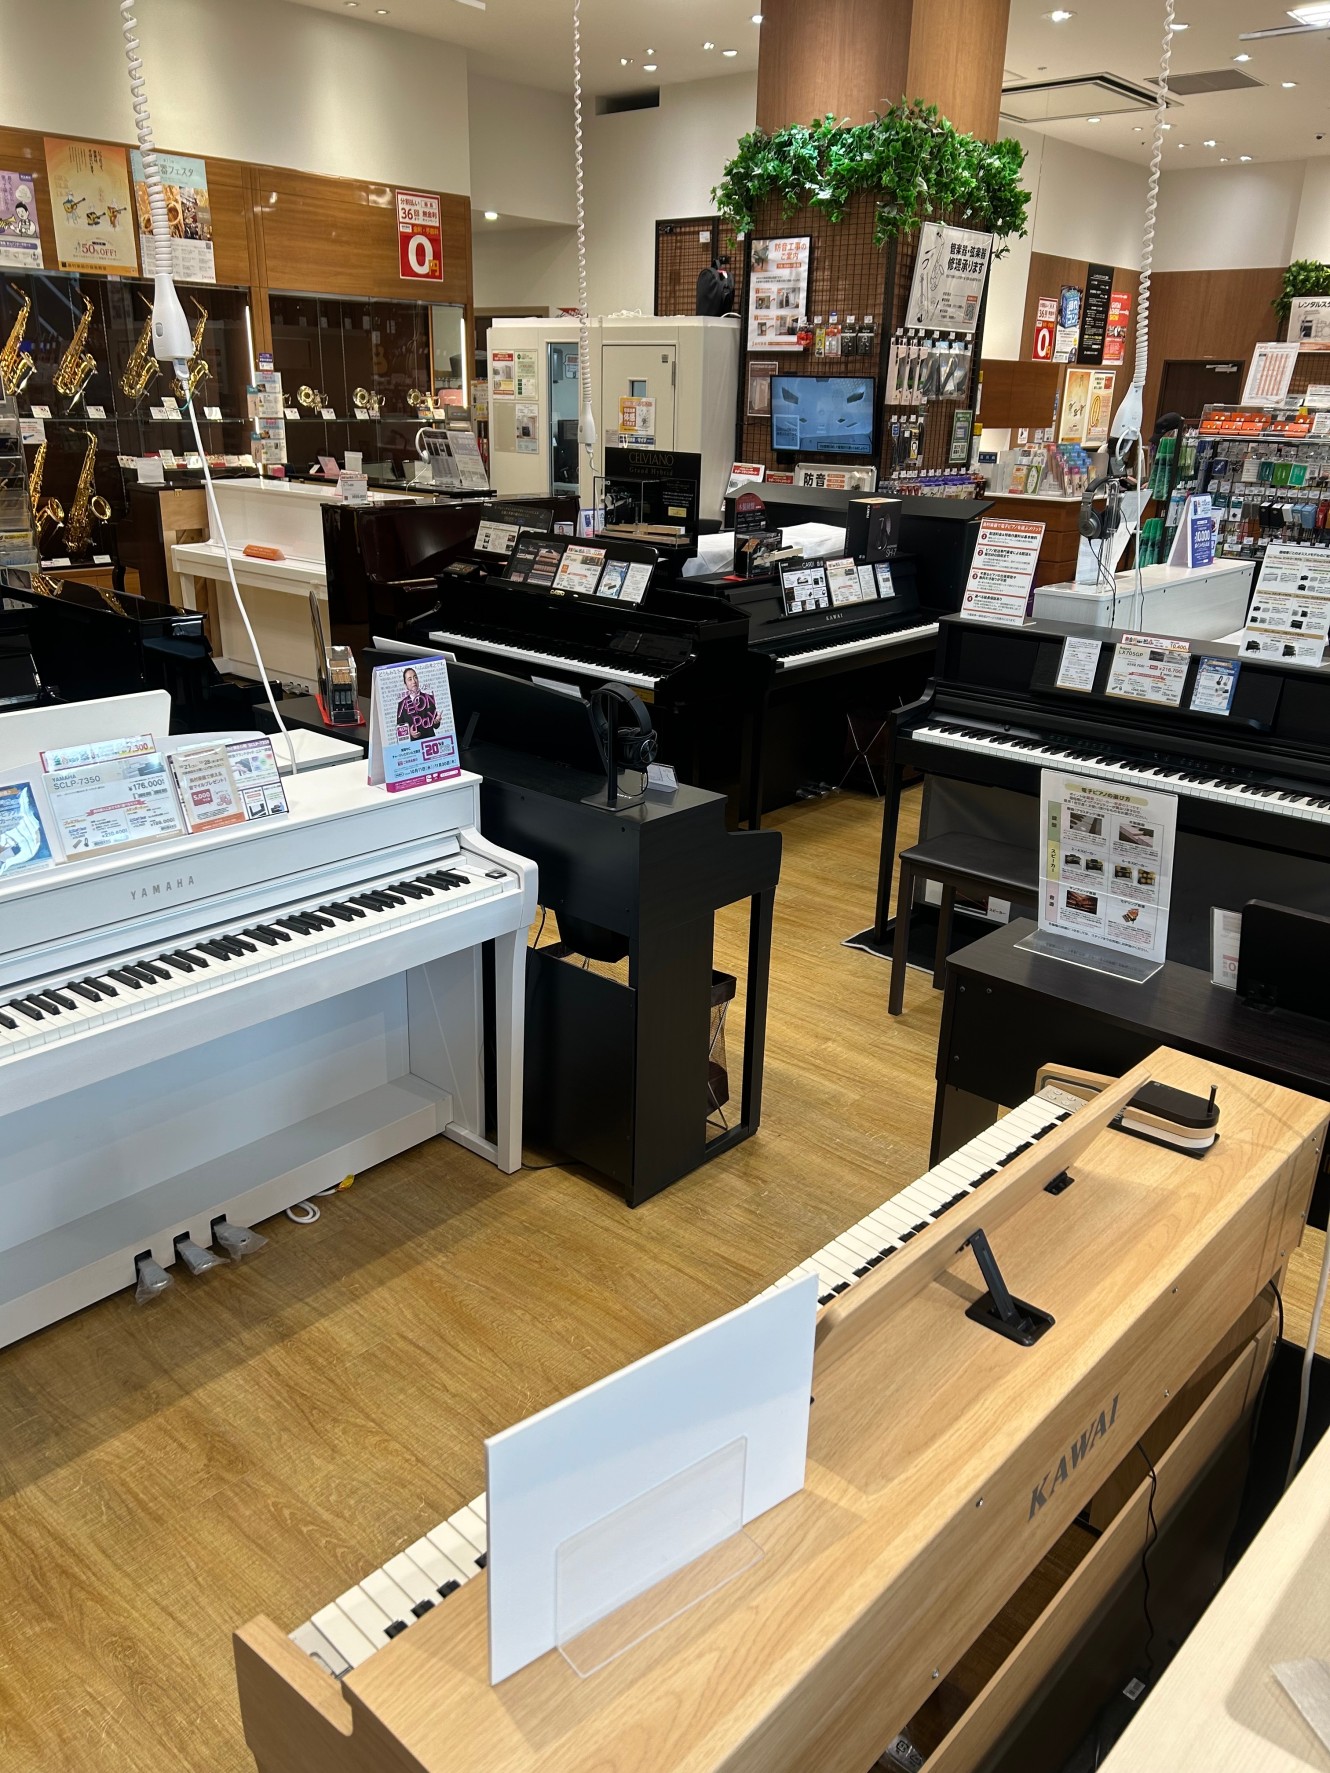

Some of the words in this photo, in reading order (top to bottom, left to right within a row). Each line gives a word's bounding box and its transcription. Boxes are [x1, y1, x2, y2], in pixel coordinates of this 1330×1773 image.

[774, 242, 806, 252] 防音工事の
[950, 242, 987, 260] 管楽器・弦楽器
[780, 252, 798, 260] ご案内
[947, 256, 984, 274] 修理承ります
[628, 452, 674, 466] CELVIANO
[804, 472, 826, 488] 防音
[52, 774, 76, 782] YAMAHA
[54, 776, 100, 790] SCLP-7350
[1082, 788, 1130, 803] 電子ピアノの選び方
[130, 876, 194, 900] YAMAHA
[1028, 1391, 1120, 1522] KAWAI
